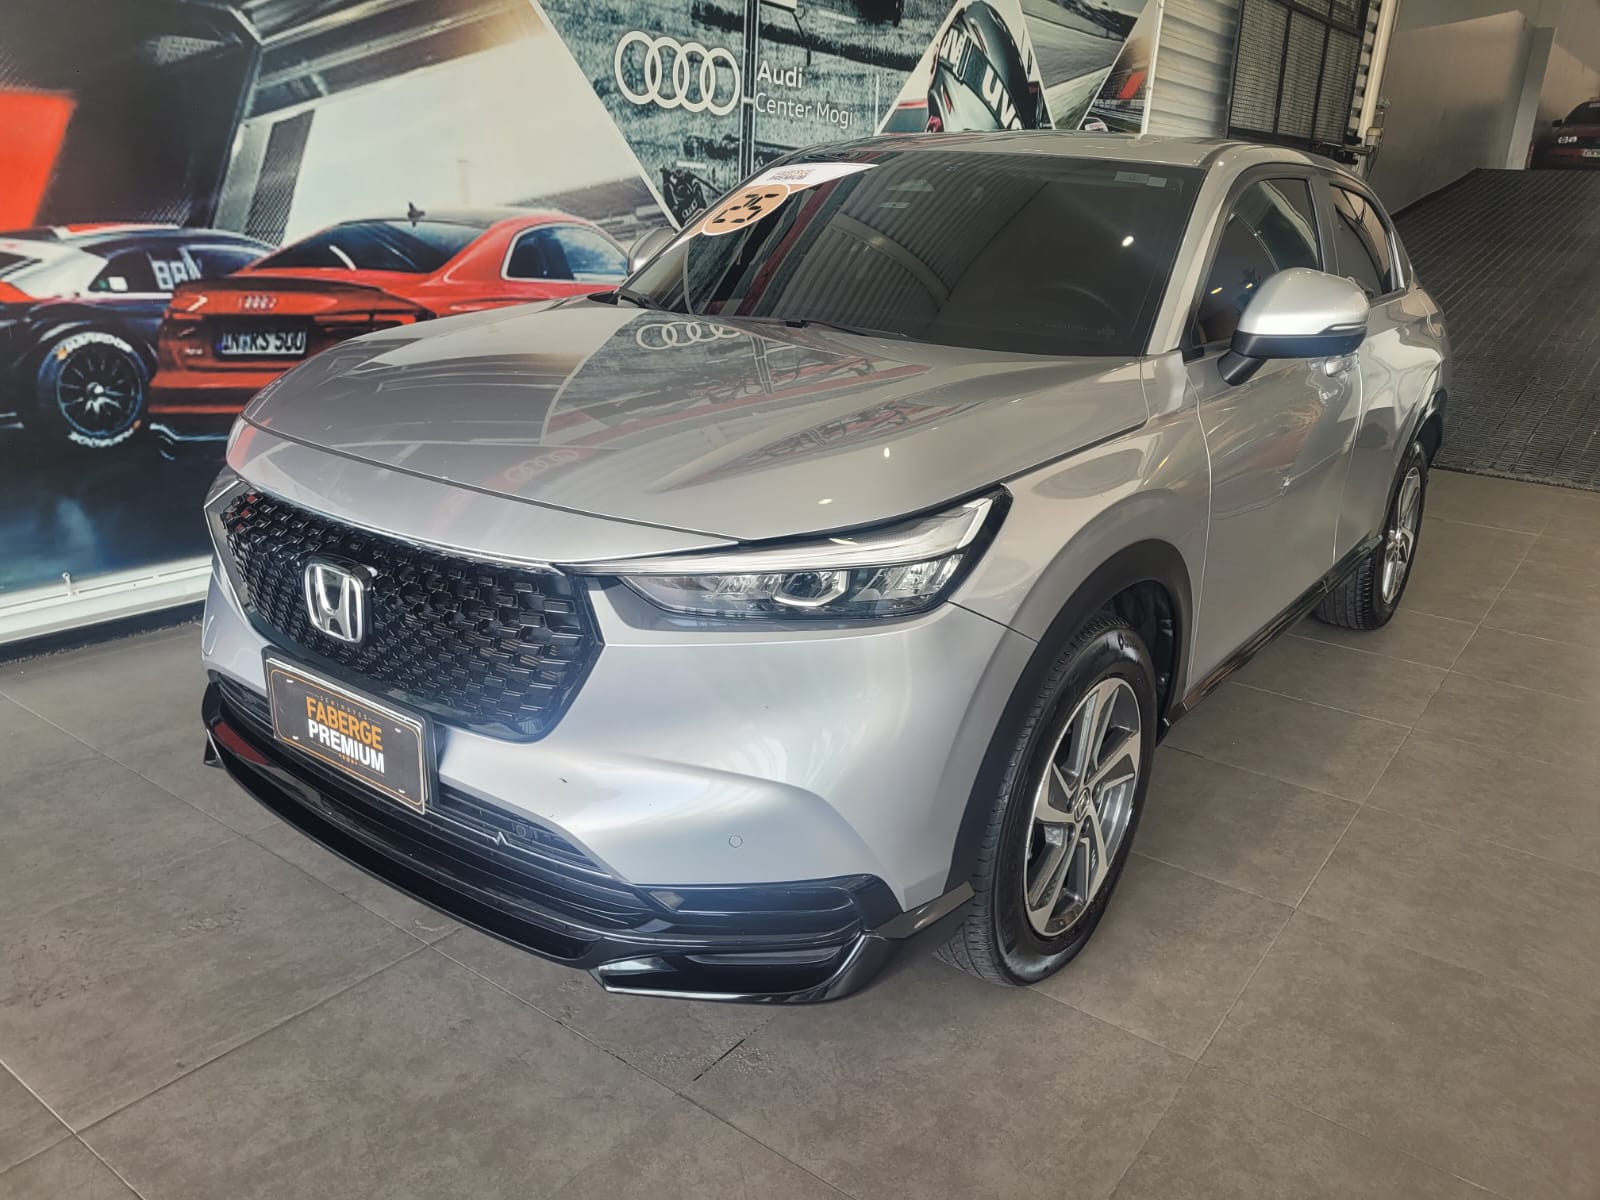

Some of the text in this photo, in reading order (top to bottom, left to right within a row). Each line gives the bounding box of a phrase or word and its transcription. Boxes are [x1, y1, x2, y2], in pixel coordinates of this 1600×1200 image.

[757, 60, 803, 88] Audi
[755, 92, 853, 129] Center Mogi
[306, 696, 384, 751] FABERGE
[307, 718, 386, 774] PREMIUM
